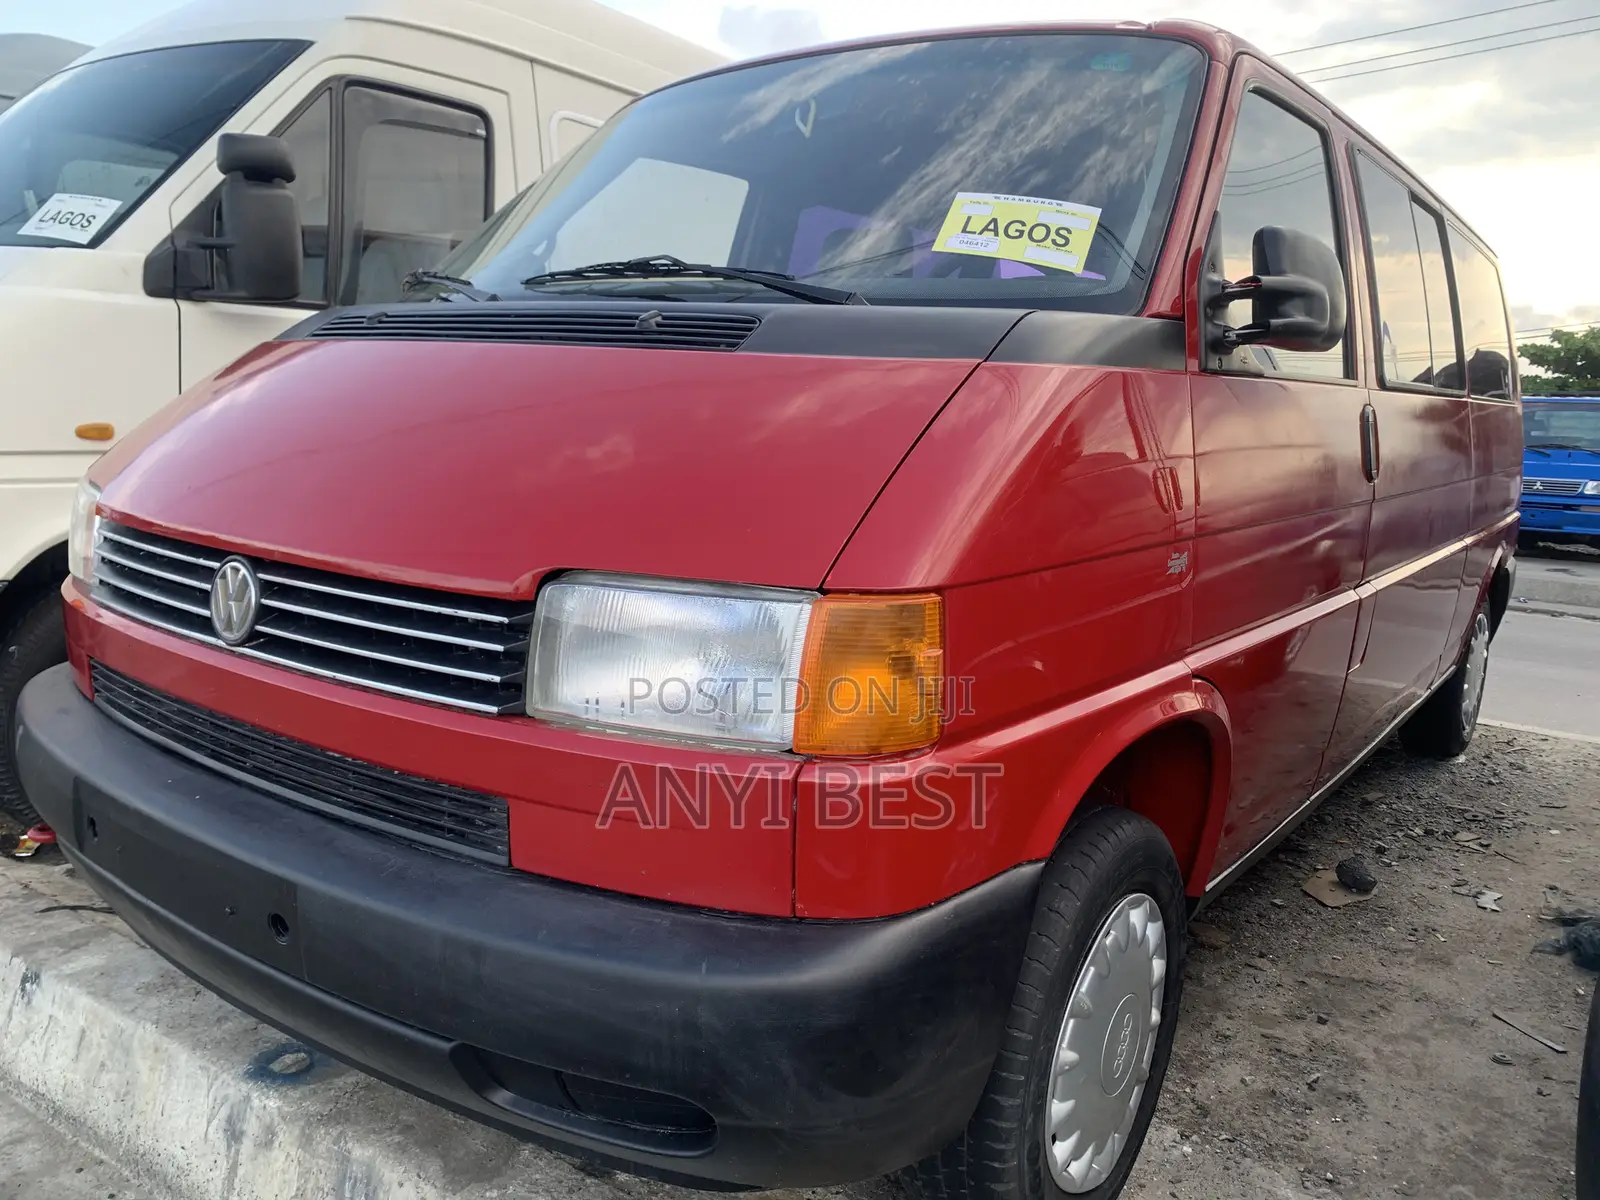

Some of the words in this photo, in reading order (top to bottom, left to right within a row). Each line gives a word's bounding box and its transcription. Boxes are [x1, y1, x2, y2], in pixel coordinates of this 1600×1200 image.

[1003, 196, 1053, 206] HAMBURG
[39, 209, 96, 228] LAGOS
[961, 215, 1073, 248] LAGOS
[958, 239, 990, 248] 046412
